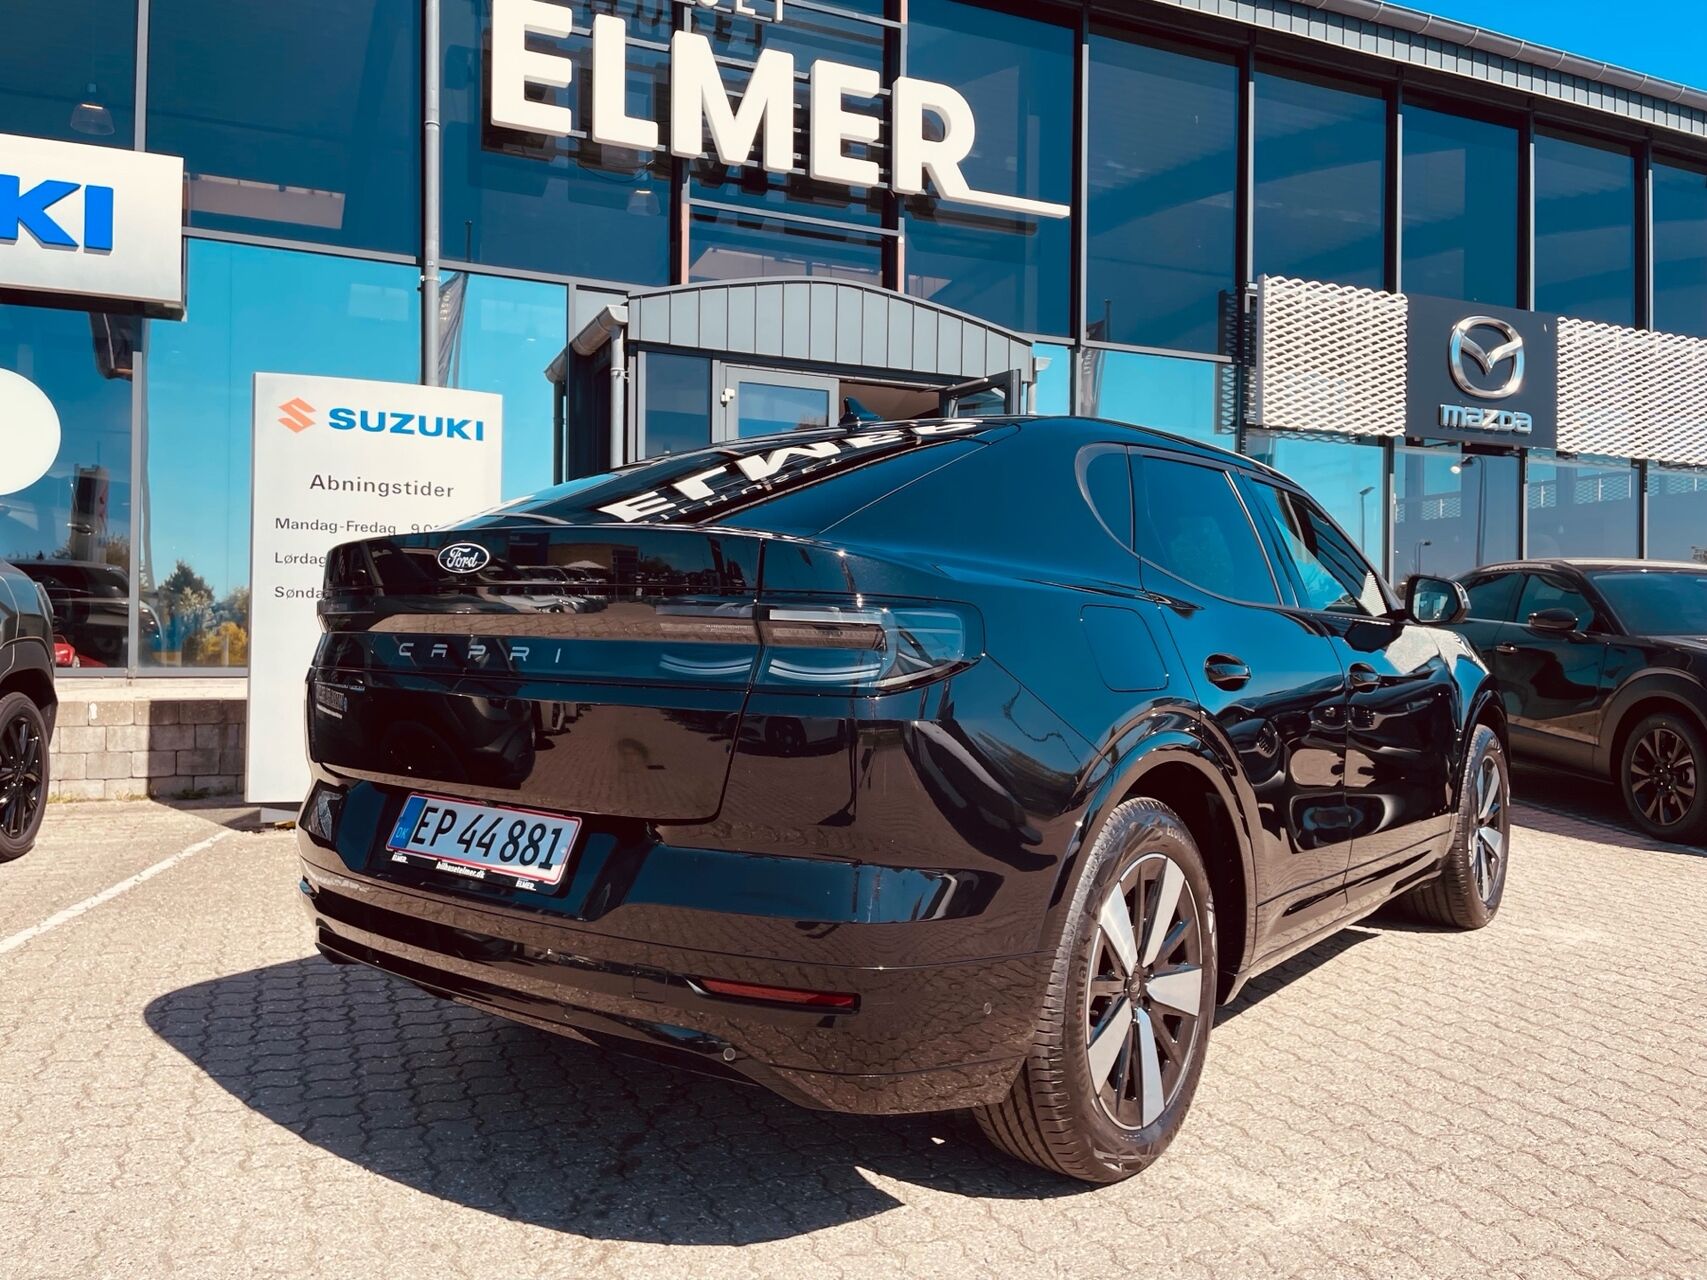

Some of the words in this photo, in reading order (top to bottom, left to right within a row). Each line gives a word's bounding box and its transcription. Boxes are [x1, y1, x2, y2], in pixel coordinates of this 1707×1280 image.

[491, 0, 1070, 218] ELMER
[328, 407, 485, 442] SUZUKI
[446, 547, 478, 568] Ford
[274, 585, 325, 599] Sønda
[398, 643, 561, 664] CAPRI
[396, 827, 409, 840] DK
[411, 806, 457, 847] EP
[457, 814, 504, 857] 44
[499, 820, 563, 870] 881
